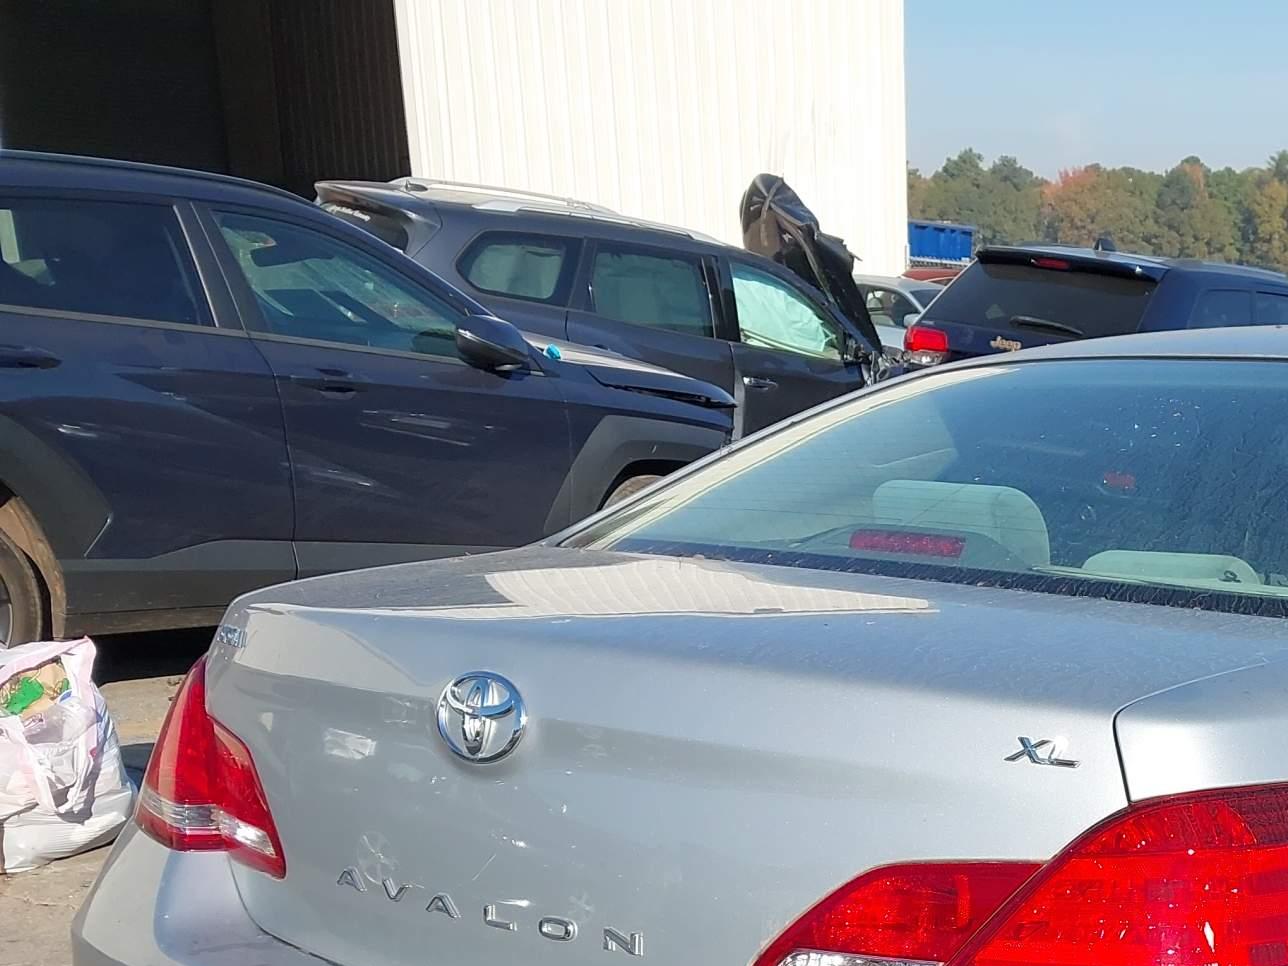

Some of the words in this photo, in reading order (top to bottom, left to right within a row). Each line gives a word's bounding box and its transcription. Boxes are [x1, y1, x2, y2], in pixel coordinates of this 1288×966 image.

[990, 336, 1022, 352] Jeep
[1002, 736, 1080, 768] XL
[337, 867, 644, 957] AVALON
